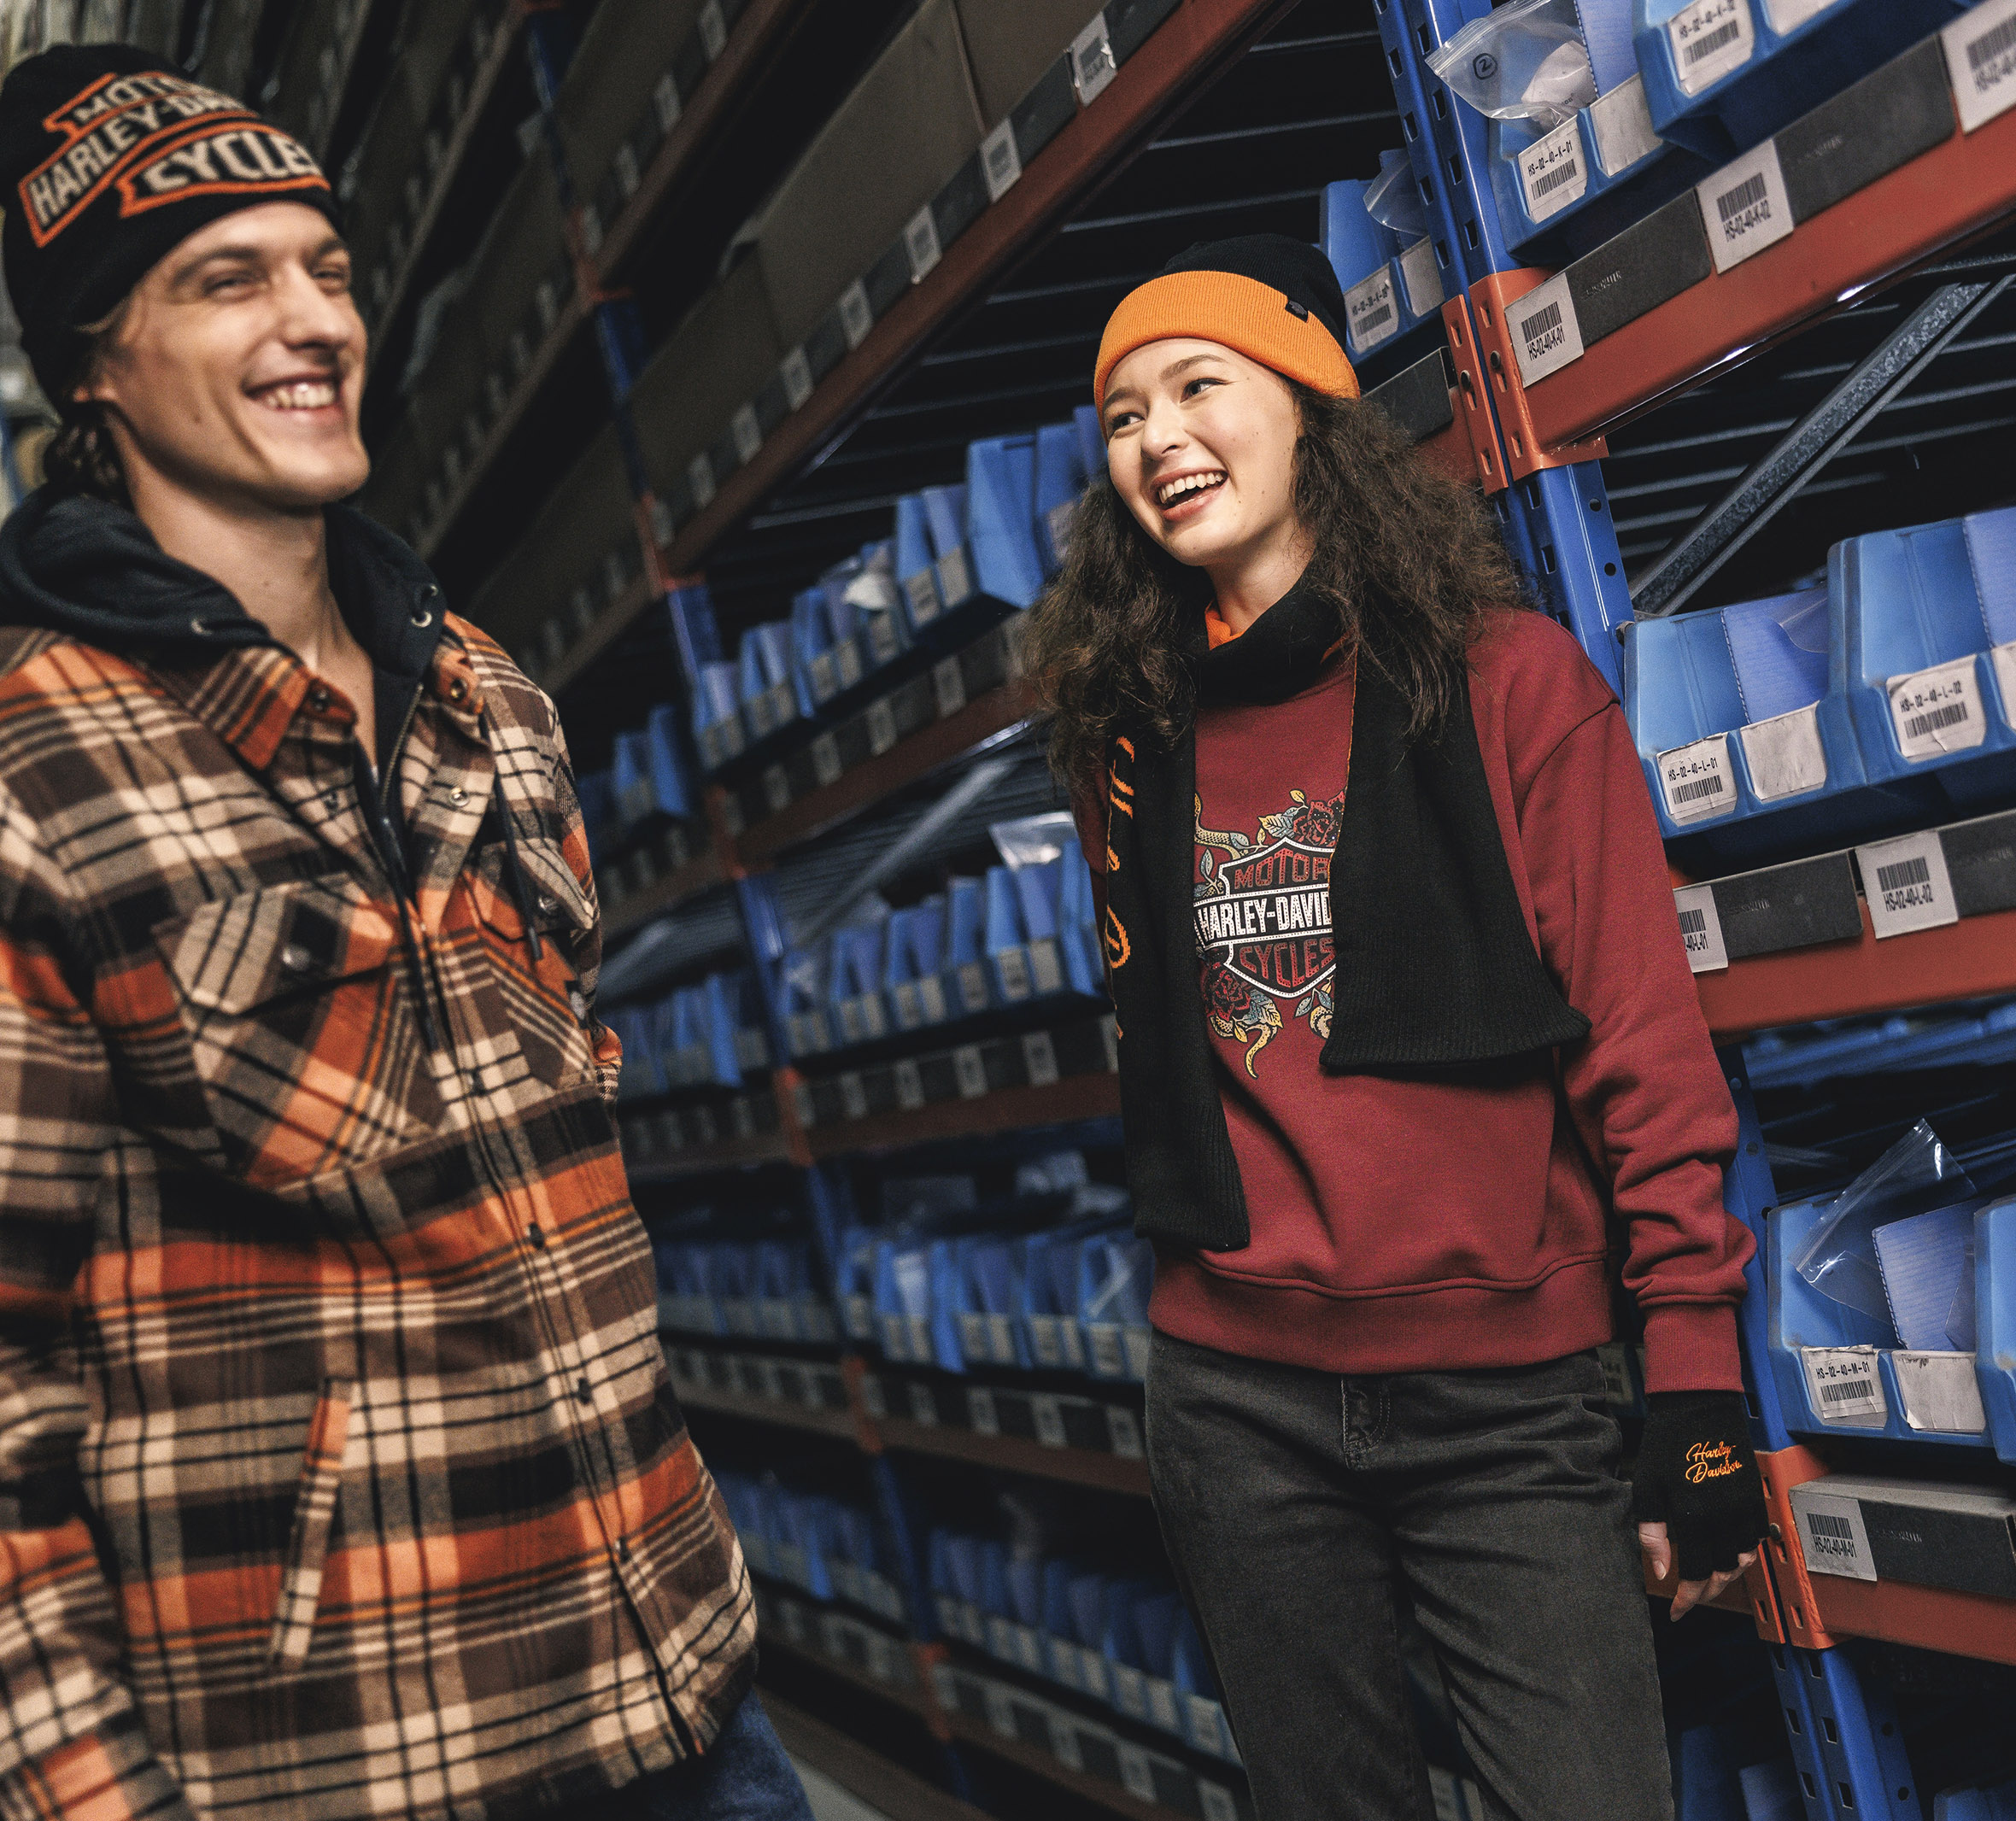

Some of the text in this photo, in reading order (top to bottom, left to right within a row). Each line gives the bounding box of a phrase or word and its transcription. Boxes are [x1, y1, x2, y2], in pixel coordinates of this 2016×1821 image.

[143, 131, 323, 194] CYCLE
[1527, 140, 1573, 177] HS-02-40-K-01
[1527, 325, 1566, 360] HS-02-40-K-01
[1667, 757, 1718, 782] HS-02-40-L-01
[1883, 883, 1933, 912] HS-02-40-L-02
[1239, 937, 1336, 988] CYCLES
[1816, 1361, 1871, 1379] HS-02-40-M-01
[1813, 1536, 1857, 1558] HS-02-40-M-01
